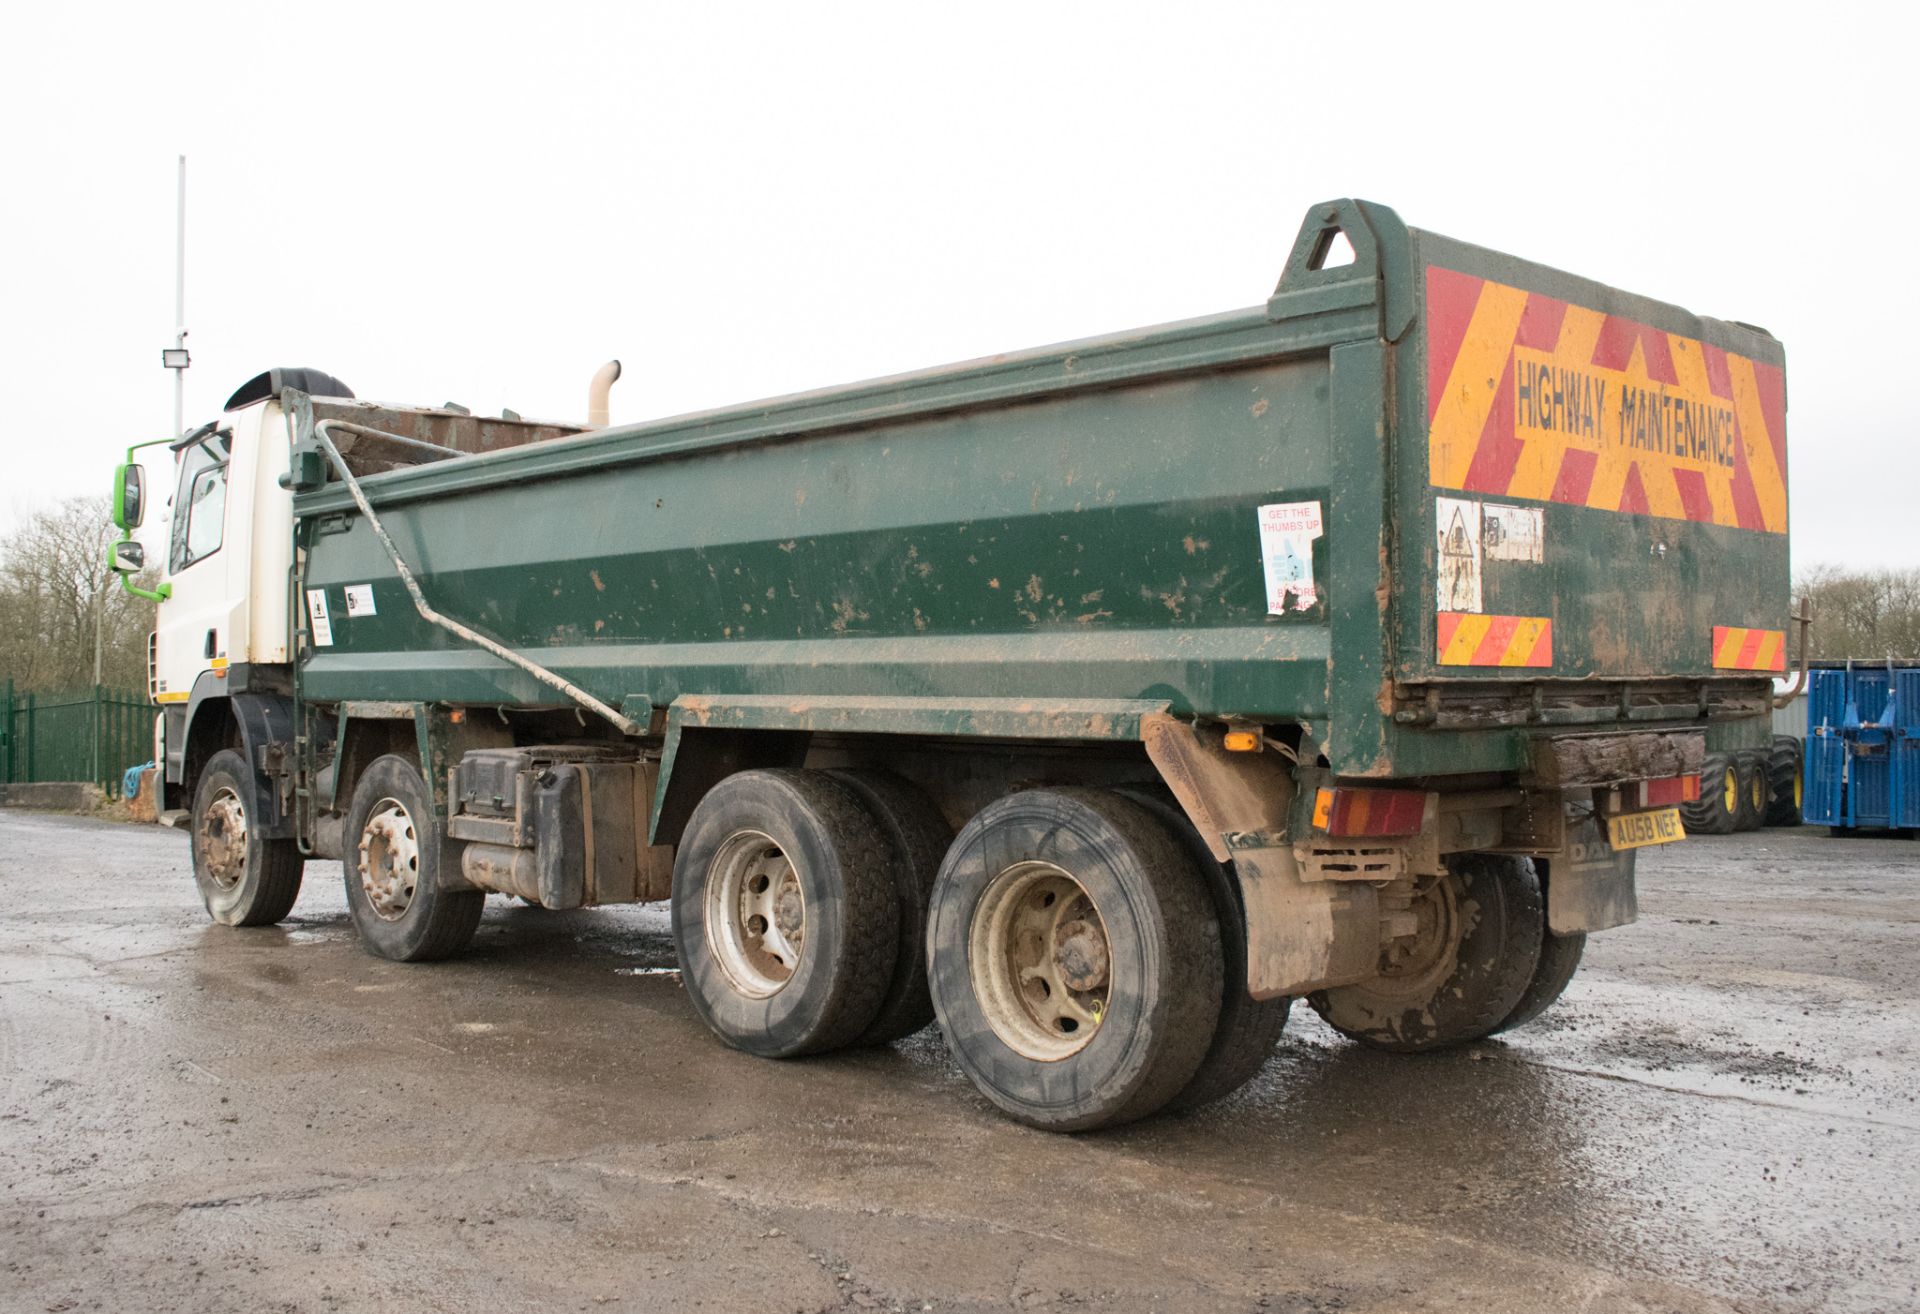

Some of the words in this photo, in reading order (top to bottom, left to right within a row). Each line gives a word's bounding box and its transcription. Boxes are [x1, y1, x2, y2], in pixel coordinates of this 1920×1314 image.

[1518, 360, 1605, 440] HIGHWAY
[1619, 385, 1734, 467] MAINTENANCE
[1268, 509, 1289, 520] GET
[1291, 507, 1312, 518] THE
[1262, 521, 1304, 533] THUMBS
[1305, 519, 1320, 530] UP
[1277, 587, 1316, 598] BORE
[1269, 600, 1311, 610] PANG
[1617, 815, 1655, 845] AU58
[1655, 812, 1677, 838] NEF
